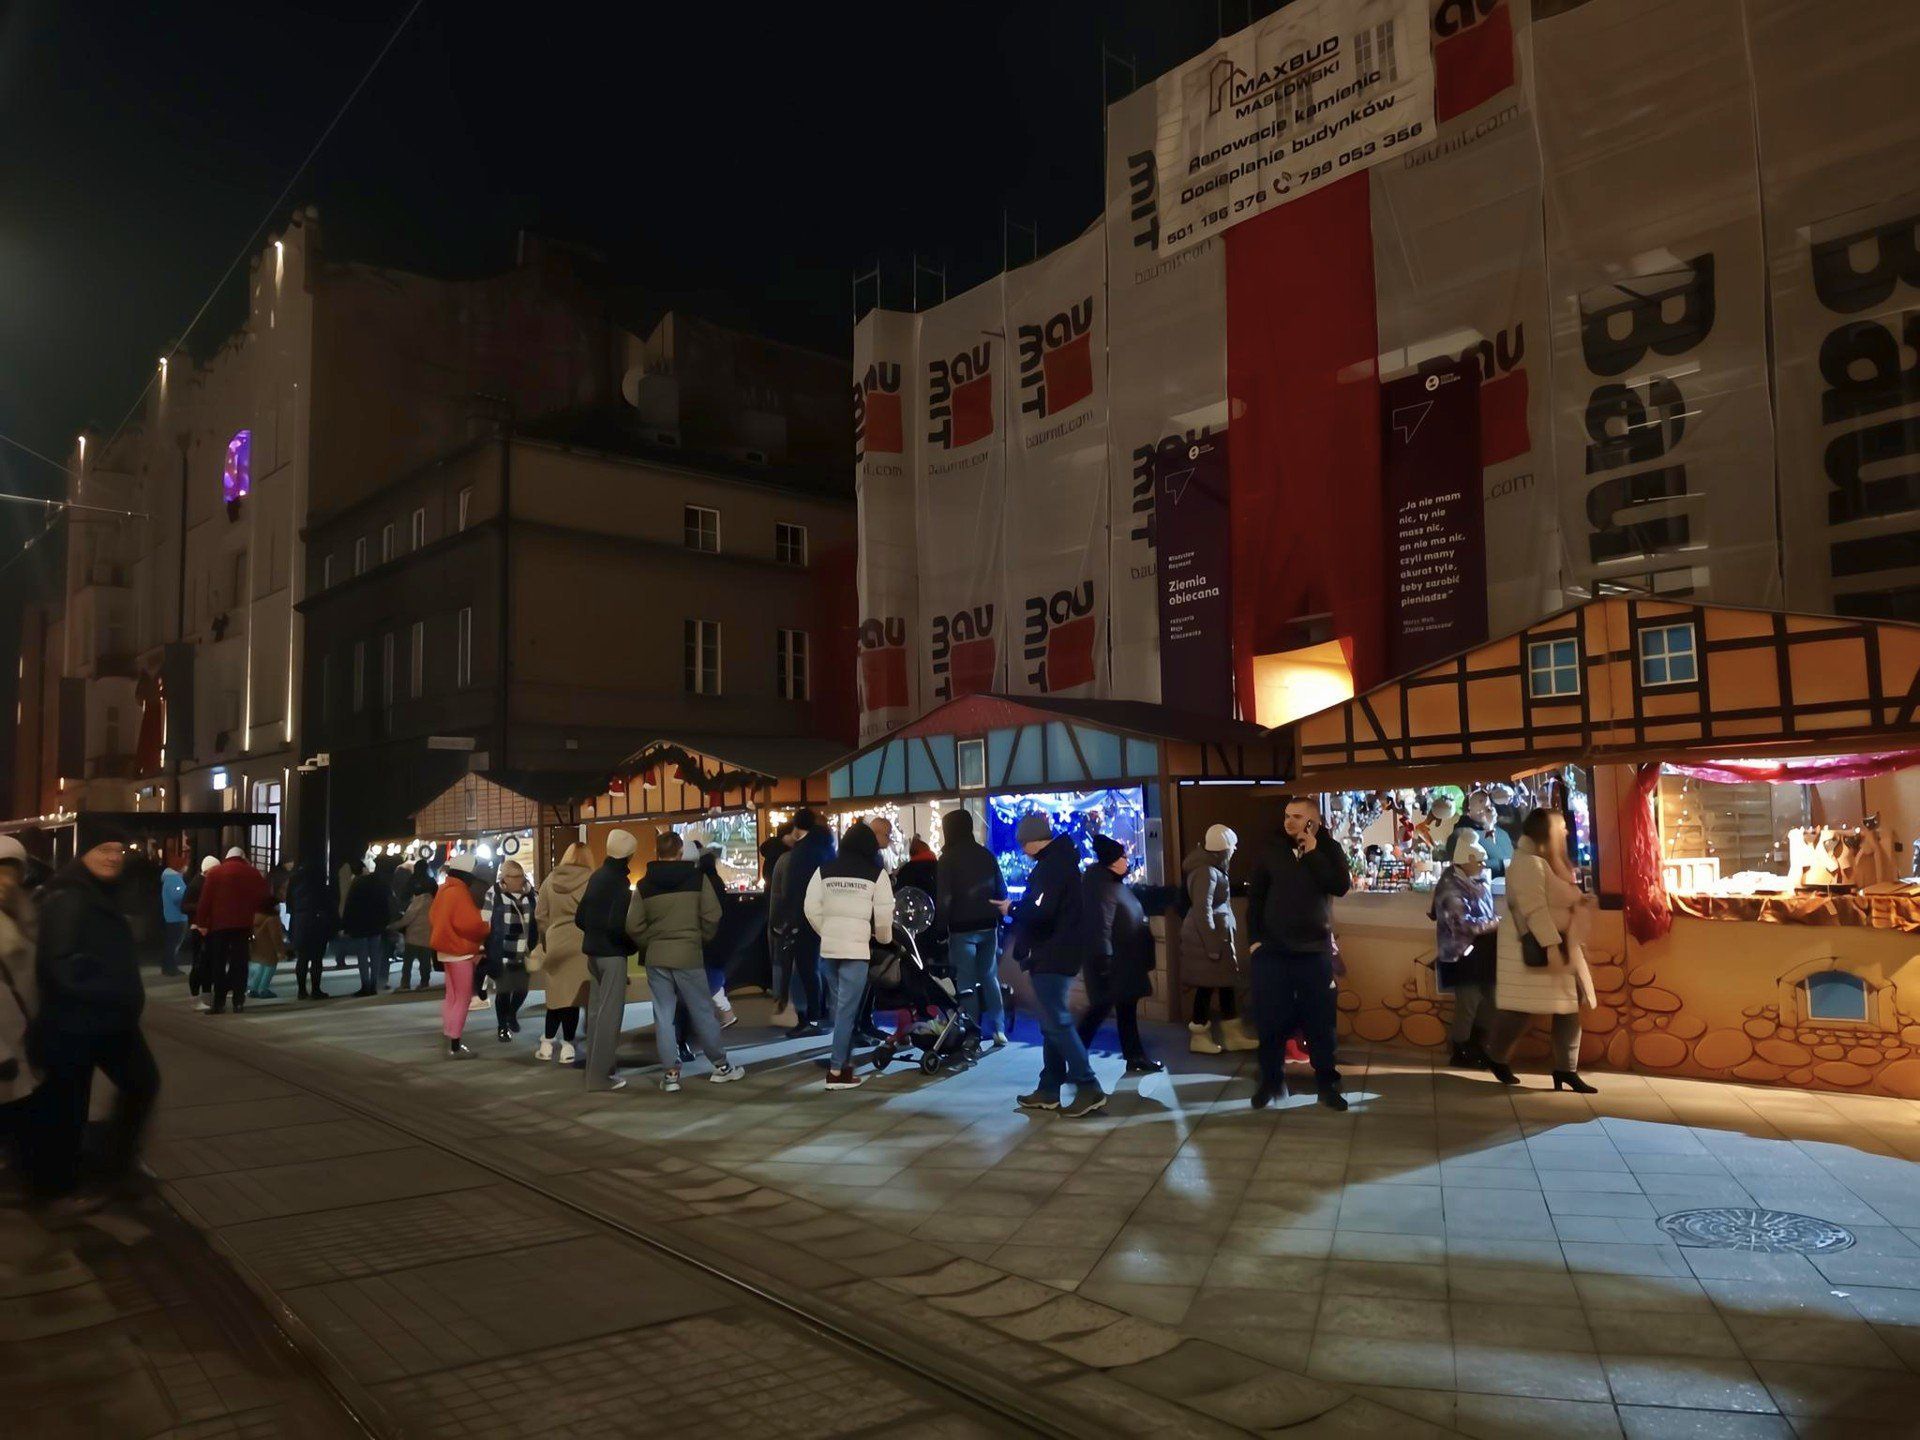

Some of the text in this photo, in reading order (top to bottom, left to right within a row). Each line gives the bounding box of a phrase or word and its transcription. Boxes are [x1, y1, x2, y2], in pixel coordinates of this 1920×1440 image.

[1235, 36, 1340, 98] MAXBUD
[1188, 70, 1381, 174] Renowacje kamienic
[1180, 95, 1396, 204] Docieplanie budynków
[1167, 223, 1193, 245] 501
[1419, 497, 1433, 507] nie
[1435, 492, 1461, 504] mam
[1431, 508, 1446, 518] nie
[1426, 523, 1445, 533] nic,
[1413, 540, 1428, 549] nie
[1424, 549, 1455, 561] mamy
[1400, 566, 1432, 579] akurat
[1168, 574, 1207, 592] Ziemia
[1168, 587, 1220, 605] obiecana
